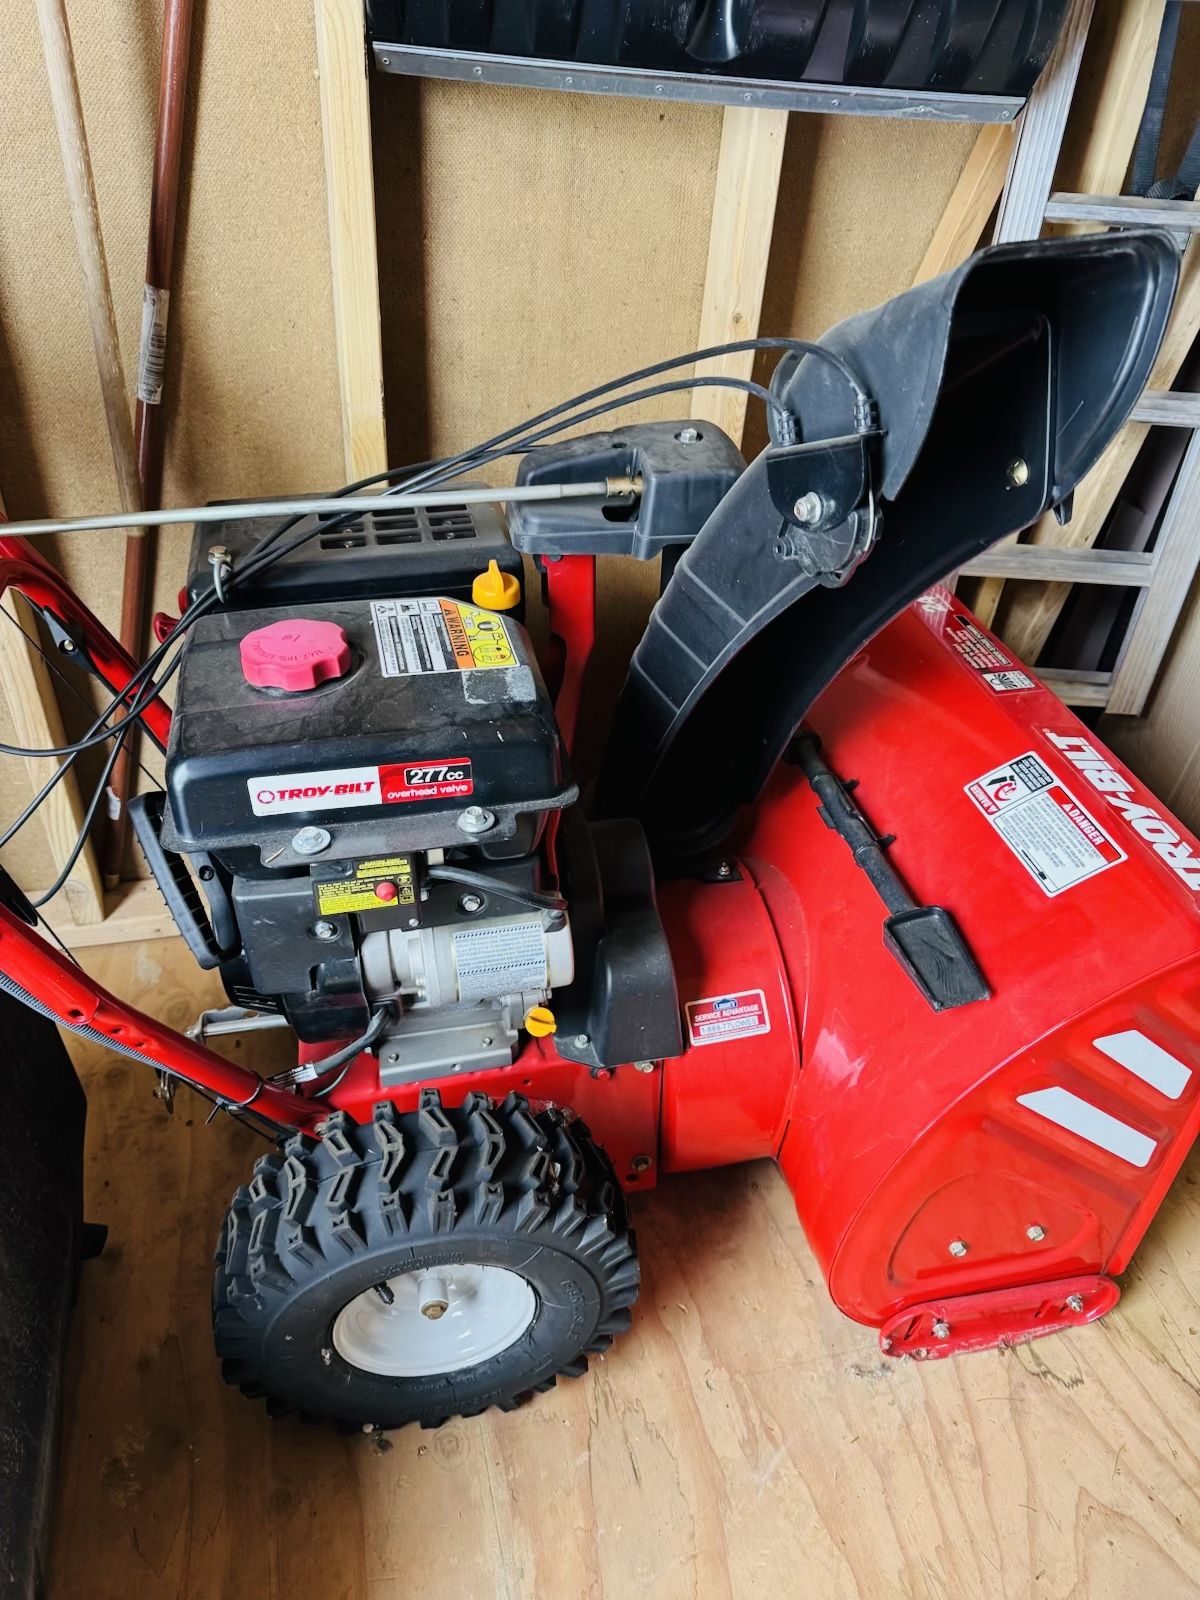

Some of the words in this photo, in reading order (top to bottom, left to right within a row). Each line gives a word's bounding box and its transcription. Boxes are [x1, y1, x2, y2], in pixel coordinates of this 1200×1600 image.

[446, 616, 470, 657] WARNING
[409, 767, 465, 784] 277cc
[277, 782, 375, 801] TROY-BILT
[387, 786, 438, 799] overhead
[439, 784, 469, 794] valve
[1045, 732, 1200, 891] TROY-BILT
[1067, 809, 1106, 846] DANGER
[694, 1012, 721, 1022] SERVICE
[722, 1004, 760, 1017] ADVANTAGE
